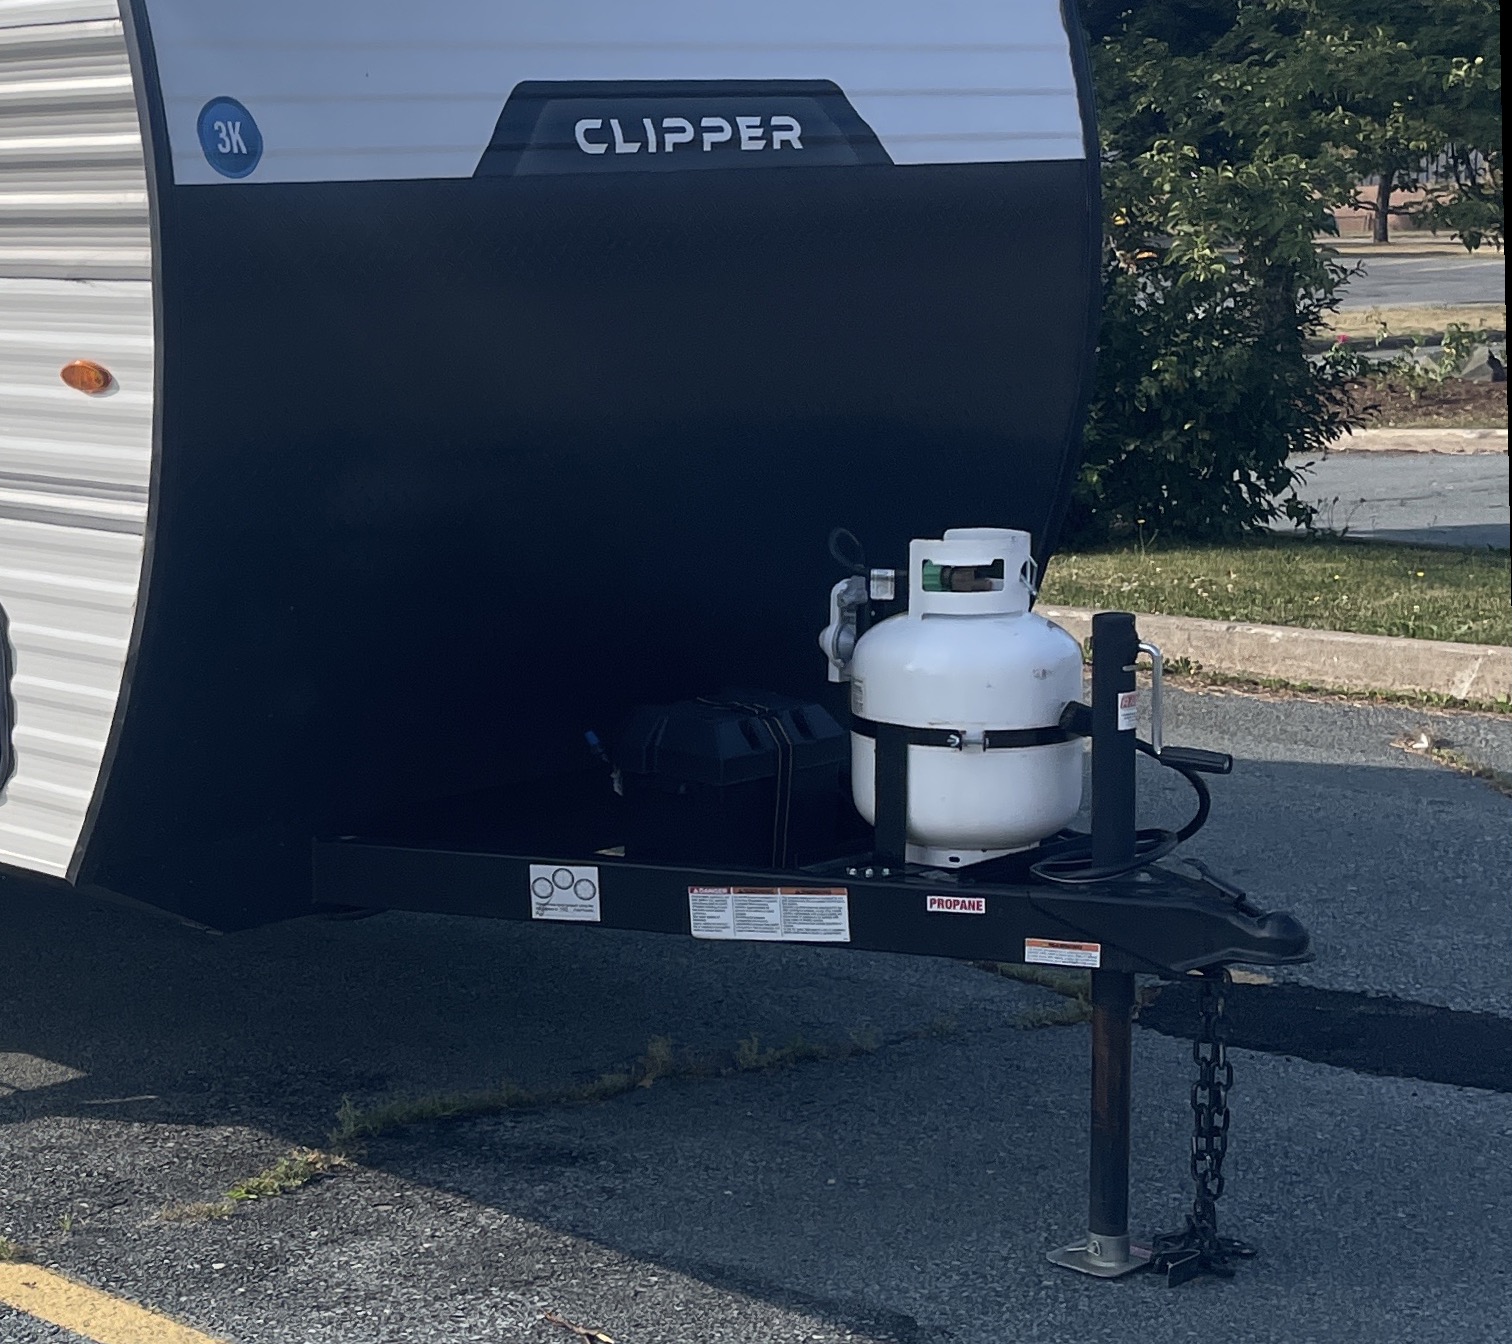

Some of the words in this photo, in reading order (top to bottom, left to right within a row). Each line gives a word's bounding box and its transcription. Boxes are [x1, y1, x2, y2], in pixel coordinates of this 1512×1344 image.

[213, 120, 248, 155] 3K
[575, 115, 804, 154] CLIPPER
[929, 898, 984, 912] PROPANE
